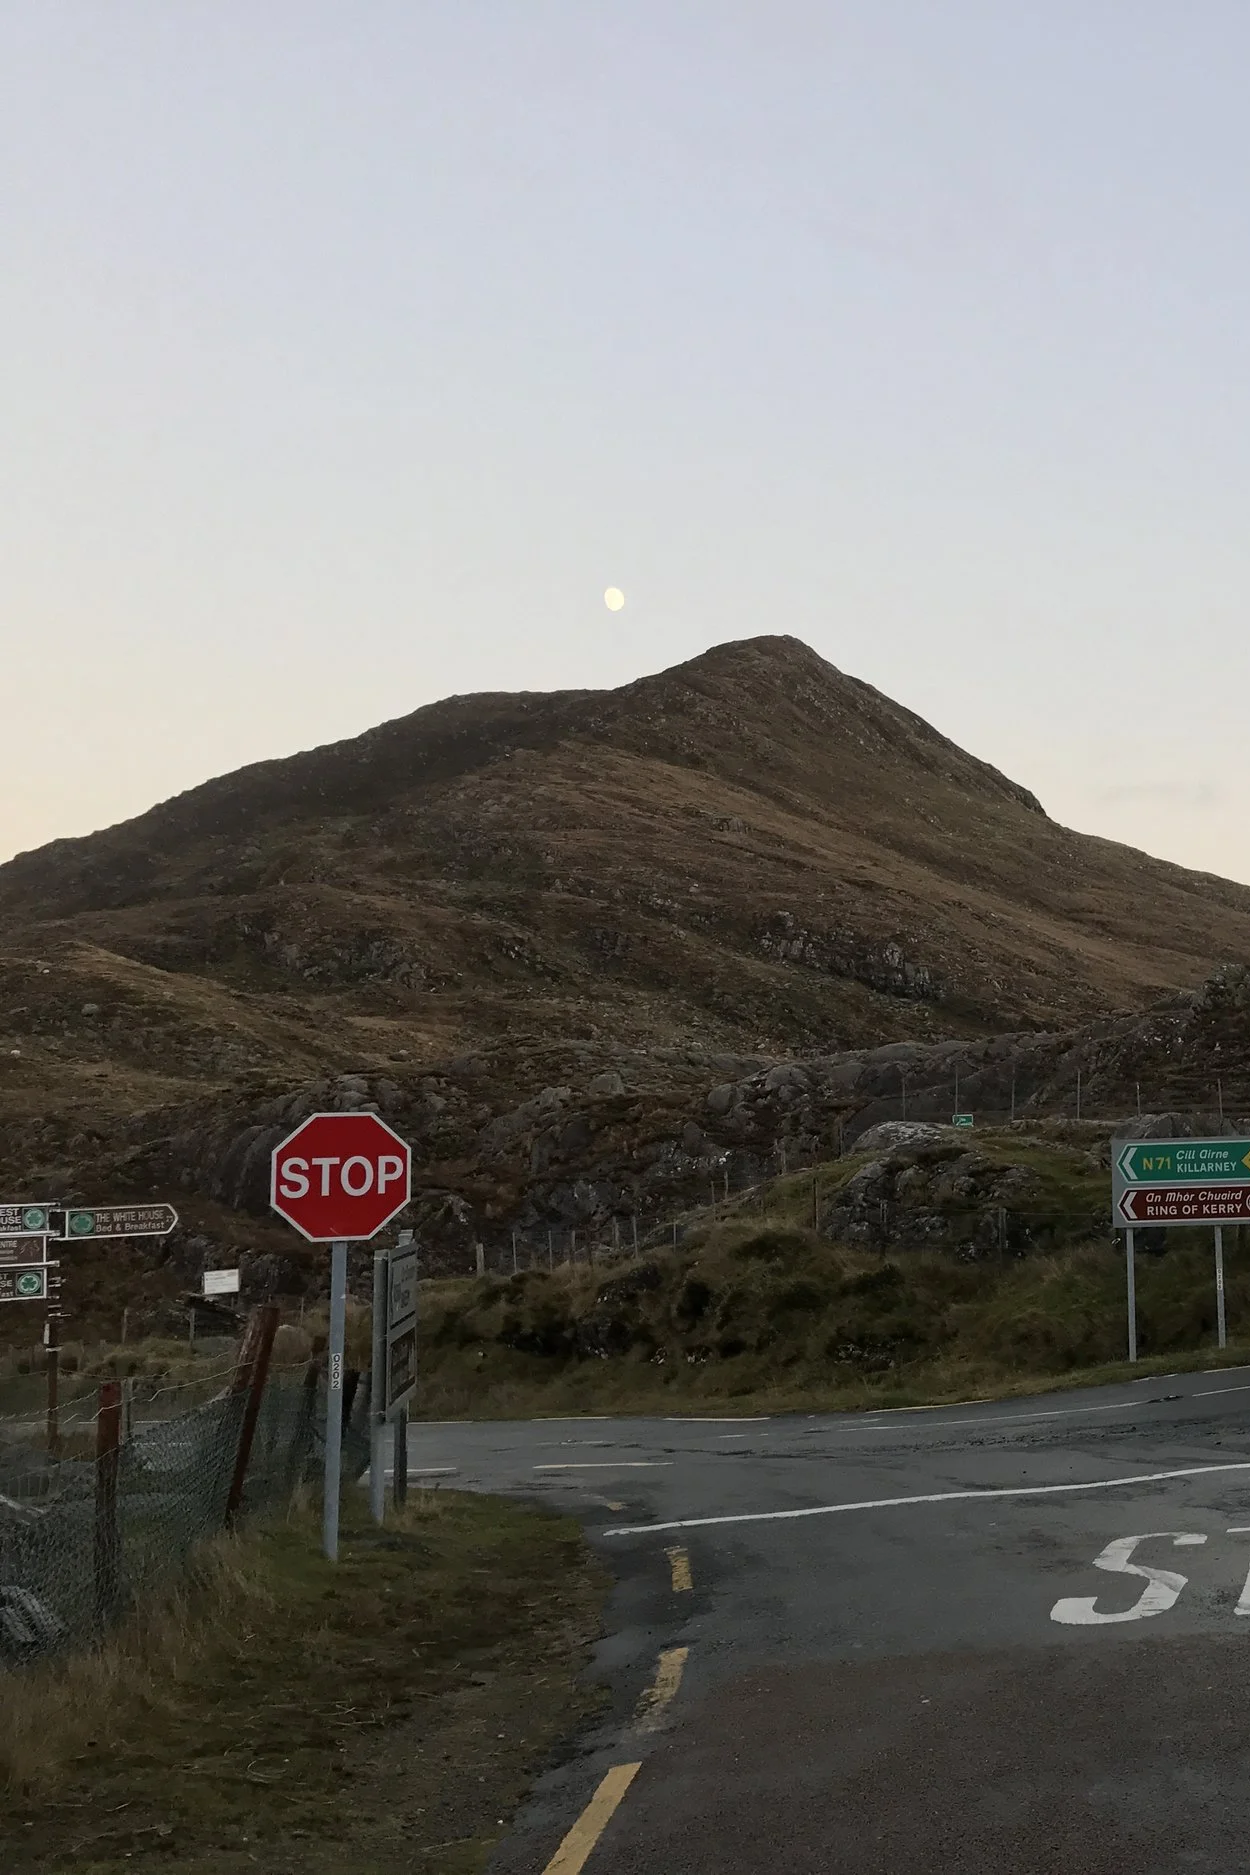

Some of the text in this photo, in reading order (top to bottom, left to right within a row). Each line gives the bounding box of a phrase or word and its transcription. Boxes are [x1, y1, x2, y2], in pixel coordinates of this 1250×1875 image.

[1175, 1150, 1196, 1161] Cill
[1176, 1161, 1237, 1173] KILLARNEY
[279, 1154, 404, 1199] STOP
[1198, 1190, 1243, 1201] Chuaird
[1147, 1203, 1243, 1216] RING OF KERRY
[95, 1212, 111, 1224] THE
[113, 1210, 136, 1222] WHITE
[138, 1209, 164, 1221] HOUSE
[95, 1221, 165, 1233] Bed & Breakfast
[332, 1354, 341, 1389] 0202
